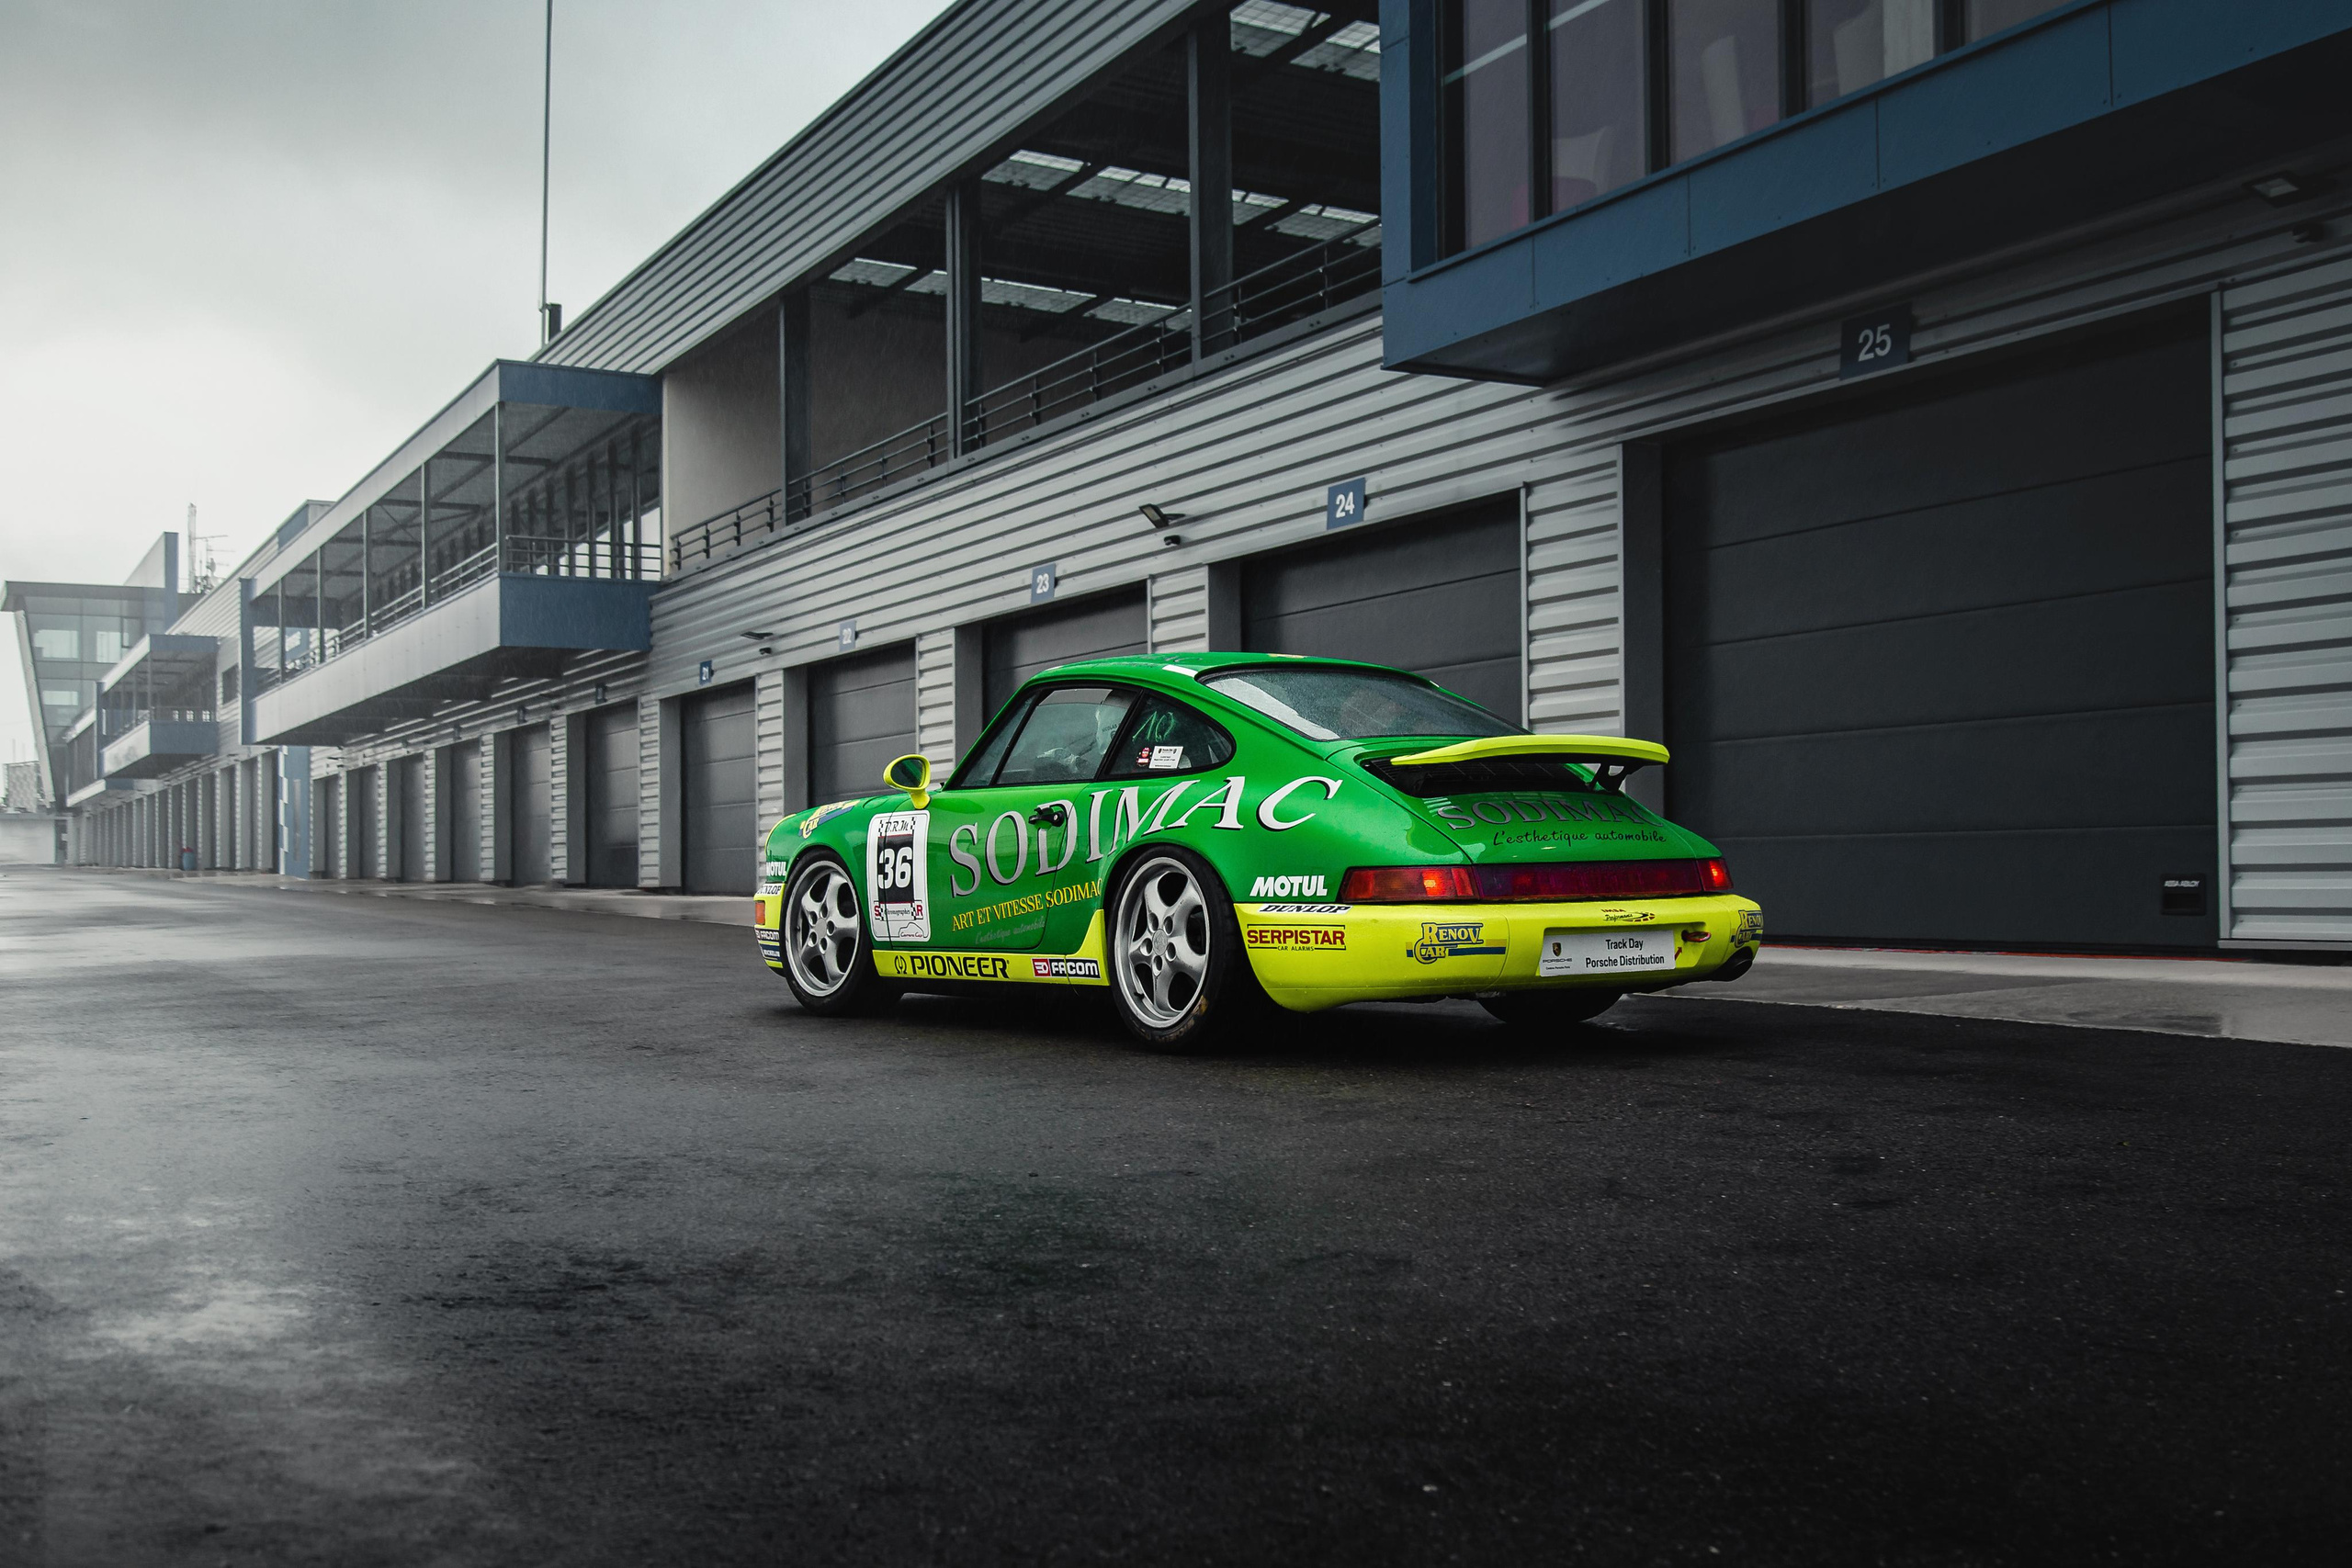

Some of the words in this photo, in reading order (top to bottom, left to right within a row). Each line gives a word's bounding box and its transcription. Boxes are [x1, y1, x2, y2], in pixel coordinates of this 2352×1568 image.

[1858, 323, 1892, 362] 25
[1335, 491, 1355, 518] 24
[1036, 573, 1049, 594] 23
[1437, 799, 1664, 830] SODIMAC
[949, 775, 1343, 898] SODIMAC
[1595, 829, 1668, 842] automobile
[878, 847, 913, 889] 36
[1250, 875, 1328, 897] MOTUL
[952, 910, 974, 931] ART
[977, 906, 991, 925] ET
[992, 893, 1044, 920] VITESSE
[1046, 877, 1102, 908] SODIMAC
[1260, 904, 1353, 914] DUNLOP
[1247, 929, 1345, 946] SERPISTAR
[1422, 922, 1483, 944] RENOV
[1605, 938, 1627, 950] Track
[1629, 937, 1643, 951] Day
[1414, 939, 1447, 964] CAR
[1586, 955, 1618, 968] Porsche
[1620, 953, 1665, 967] Distribution
[910, 955, 1009, 978] PIONEER
[1052, 961, 1099, 976] FACOM
